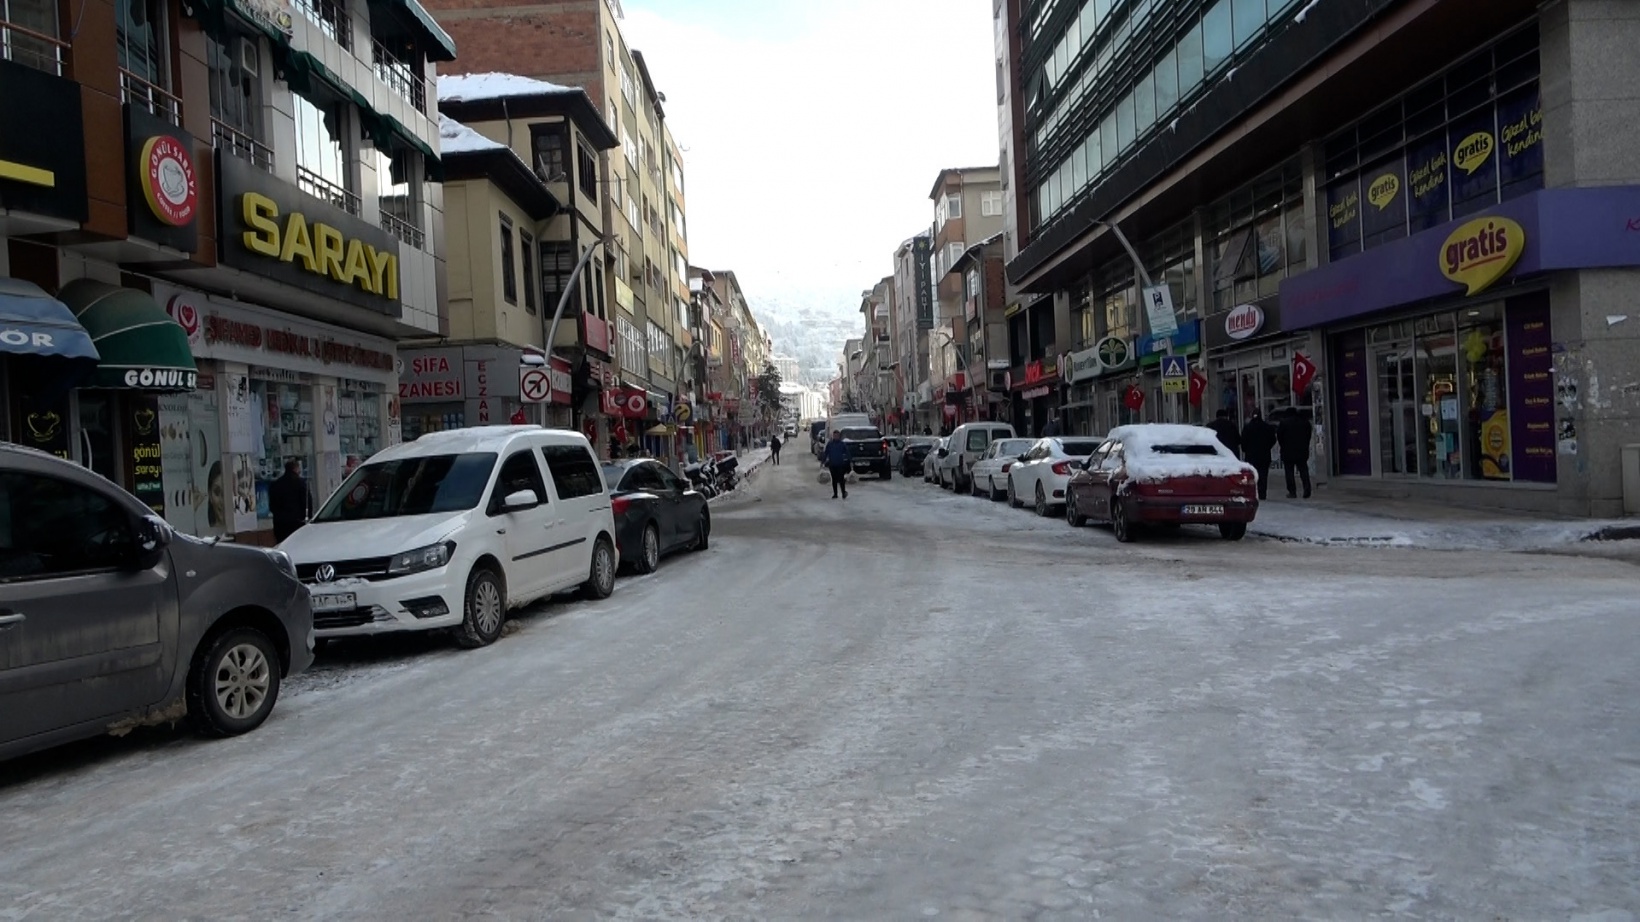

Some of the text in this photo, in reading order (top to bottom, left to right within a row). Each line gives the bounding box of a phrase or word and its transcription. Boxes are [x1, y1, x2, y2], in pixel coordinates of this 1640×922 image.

[150, 140, 171, 178] GÖNÜL
[1457, 135, 1489, 166] gratis
[1371, 177, 1396, 200] gratis
[242, 191, 398, 299] SARAYI
[1446, 222, 1507, 275] gratis
[124, 367, 184, 386] GÖNÜL
[412, 355, 449, 376] ŞİFA
[134, 443, 160, 462] gönül
